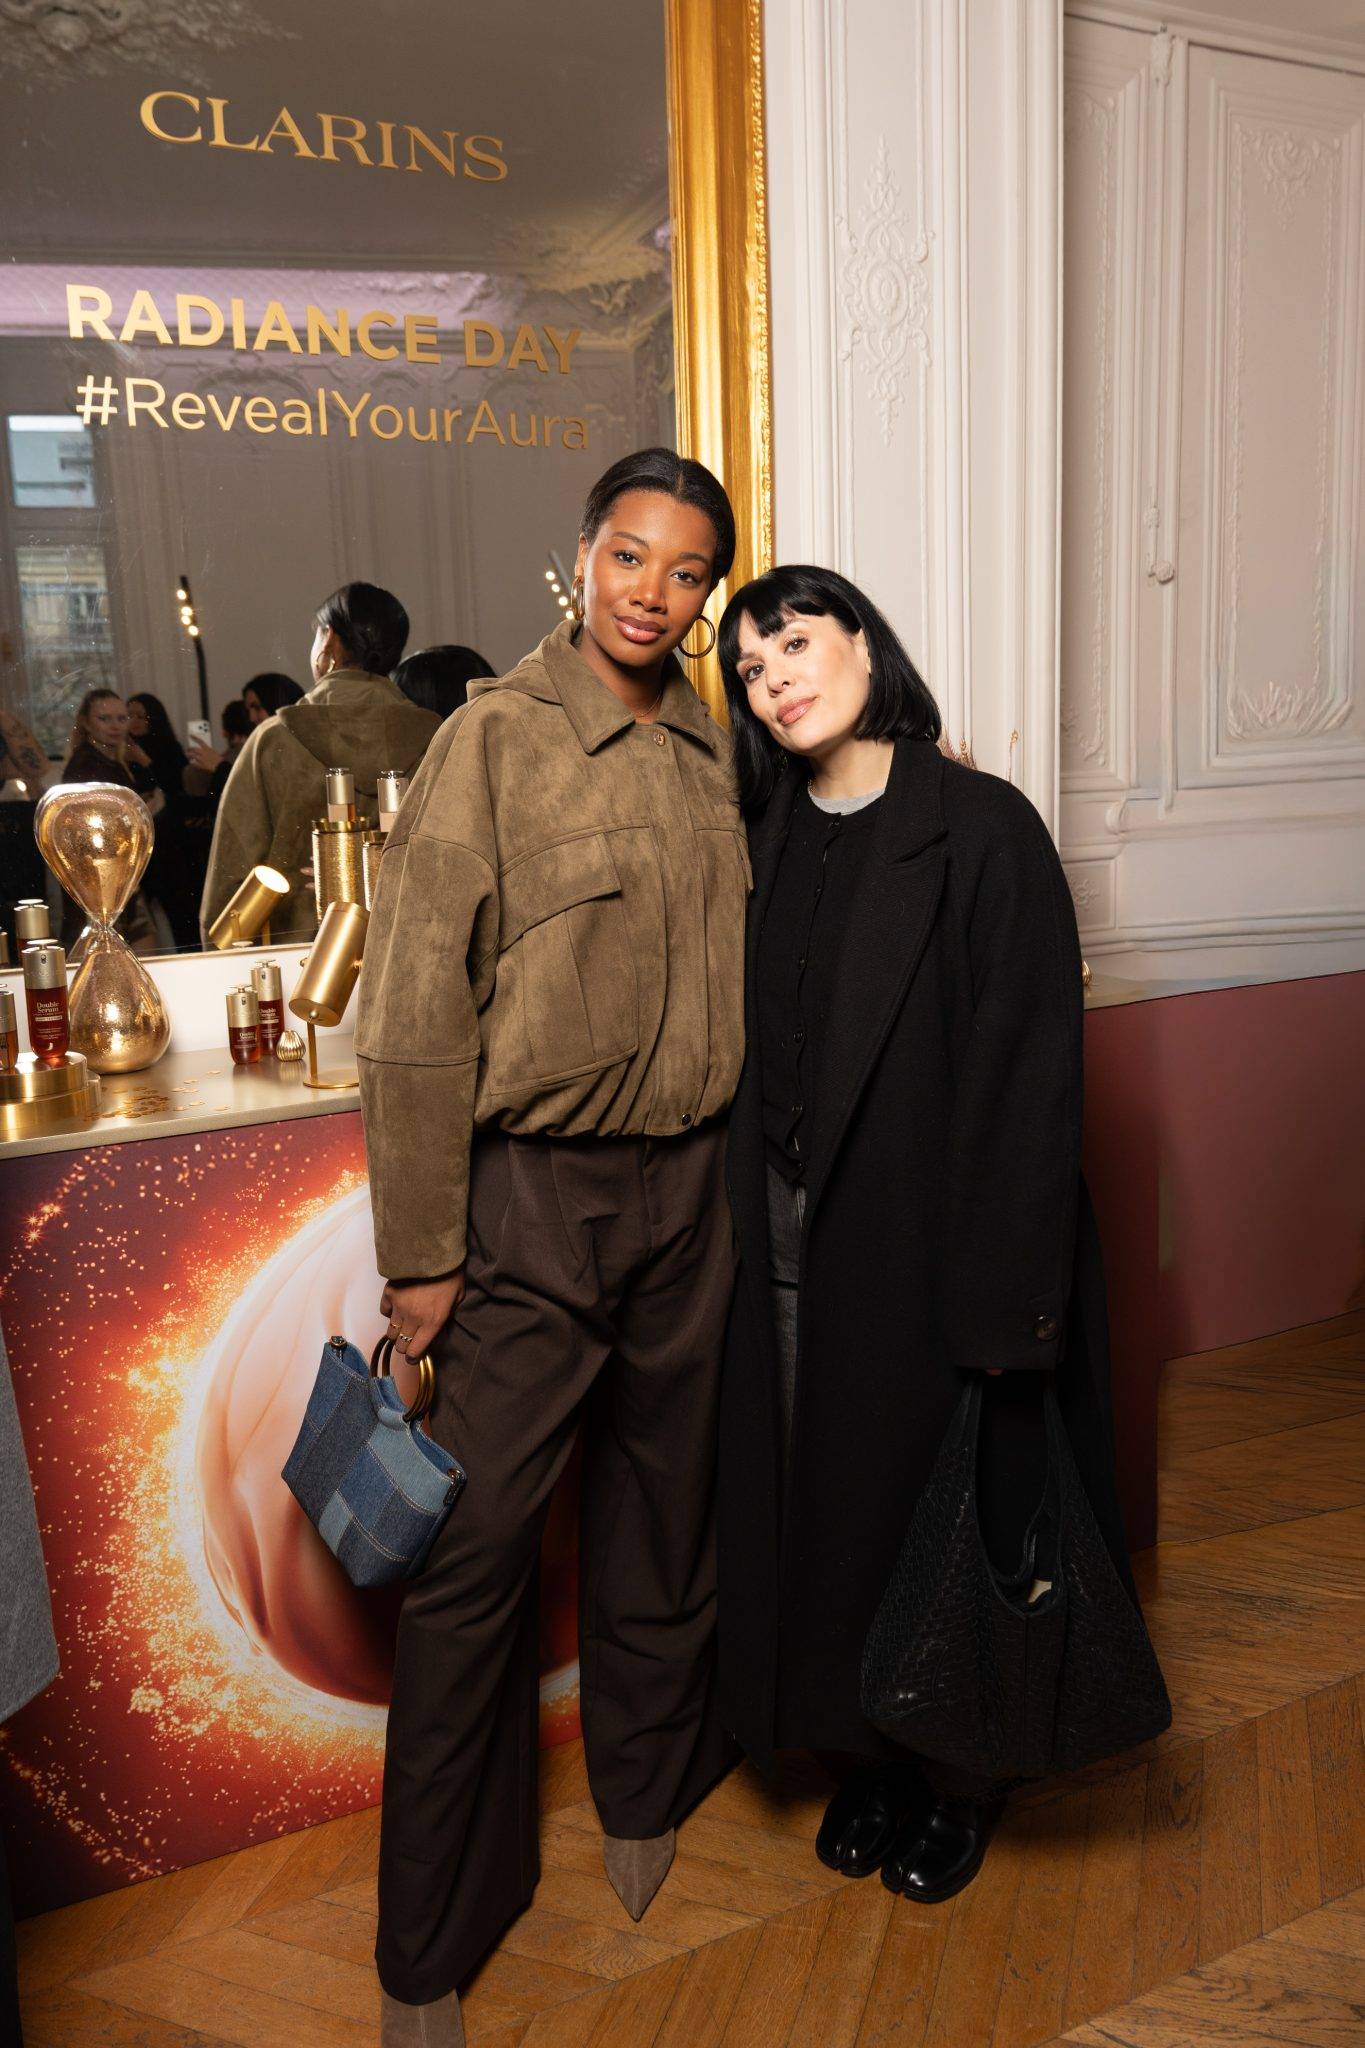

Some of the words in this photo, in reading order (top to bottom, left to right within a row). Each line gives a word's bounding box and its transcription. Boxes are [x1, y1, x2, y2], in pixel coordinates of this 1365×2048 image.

[140, 91, 509, 182] CLARINS
[66, 284, 442, 364] RADIANCE
[463, 320, 581, 374] DAY
[76, 375, 588, 449] #RevealYourAura
